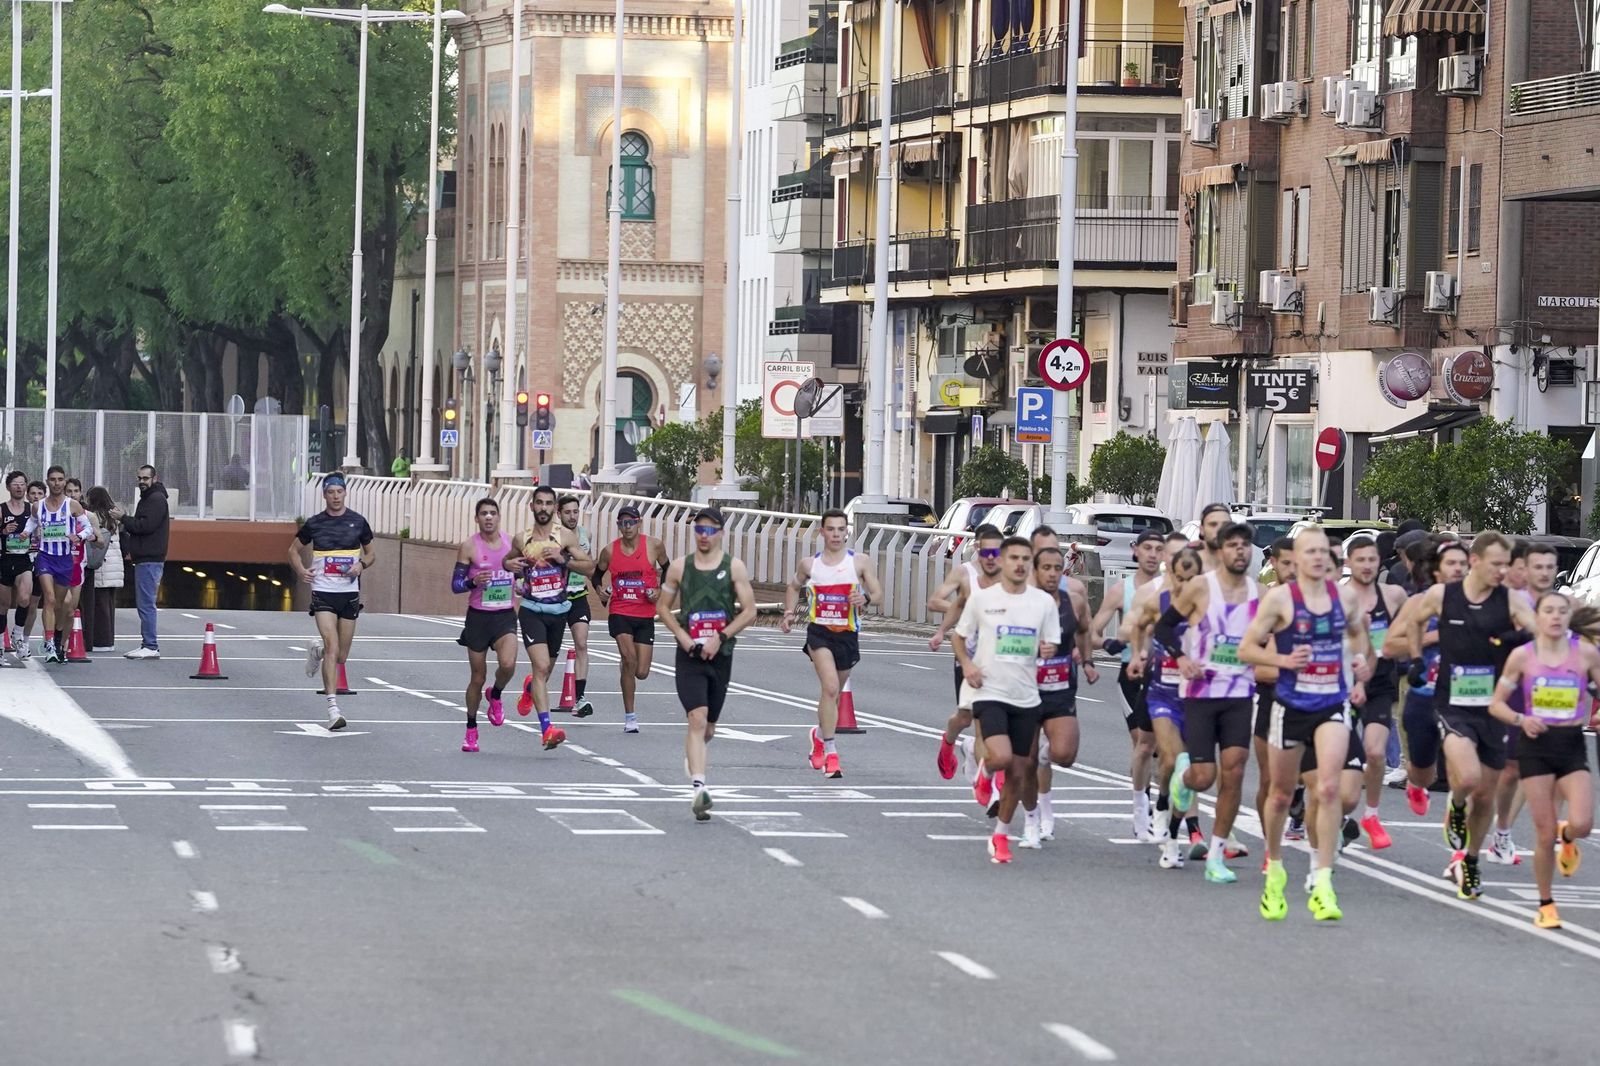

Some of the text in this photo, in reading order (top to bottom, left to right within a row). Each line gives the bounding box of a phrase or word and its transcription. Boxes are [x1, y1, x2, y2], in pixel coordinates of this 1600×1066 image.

[1138, 352, 1167, 361] LUIS
[1251, 373, 1306, 386] TINTE
[1393, 359, 1418, 397] Cruzcampo
[1453, 372, 1491, 384] Cruzcampo
[1022, 393, 1044, 421] P
